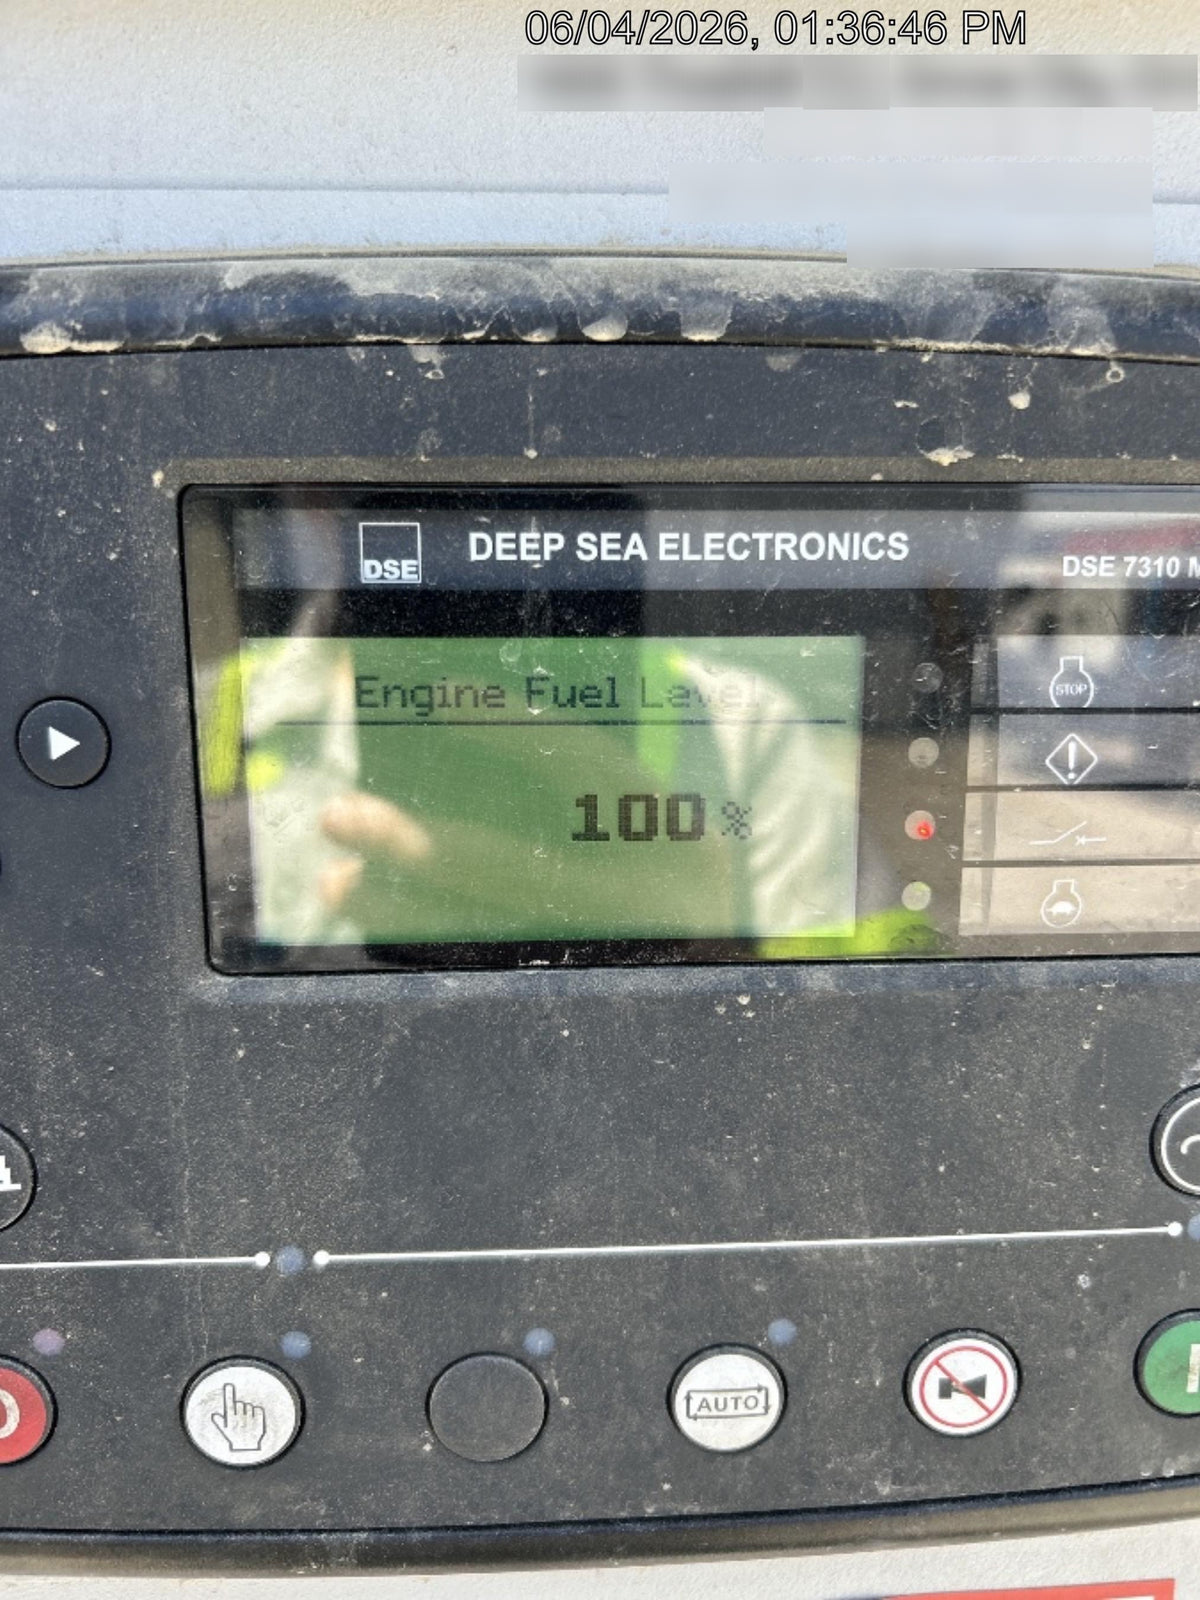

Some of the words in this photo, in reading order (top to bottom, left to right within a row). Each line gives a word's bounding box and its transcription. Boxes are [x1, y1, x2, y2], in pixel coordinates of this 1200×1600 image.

[469, 532, 564, 561] DEEP
[576, 532, 648, 561] SEA
[658, 532, 909, 561] ELECTRONICS
[363, 559, 419, 580] DSE
[1062, 556, 1116, 577] DSE
[1123, 556, 1180, 578] 7310
[355, 676, 505, 716] Engine
[525, 675, 621, 709] Fuel
[641, 676, 759, 709] Level
[1055, 683, 1088, 696] STOP
[572, 794, 706, 842] 100
[698, 1396, 760, 1412] AUTO
